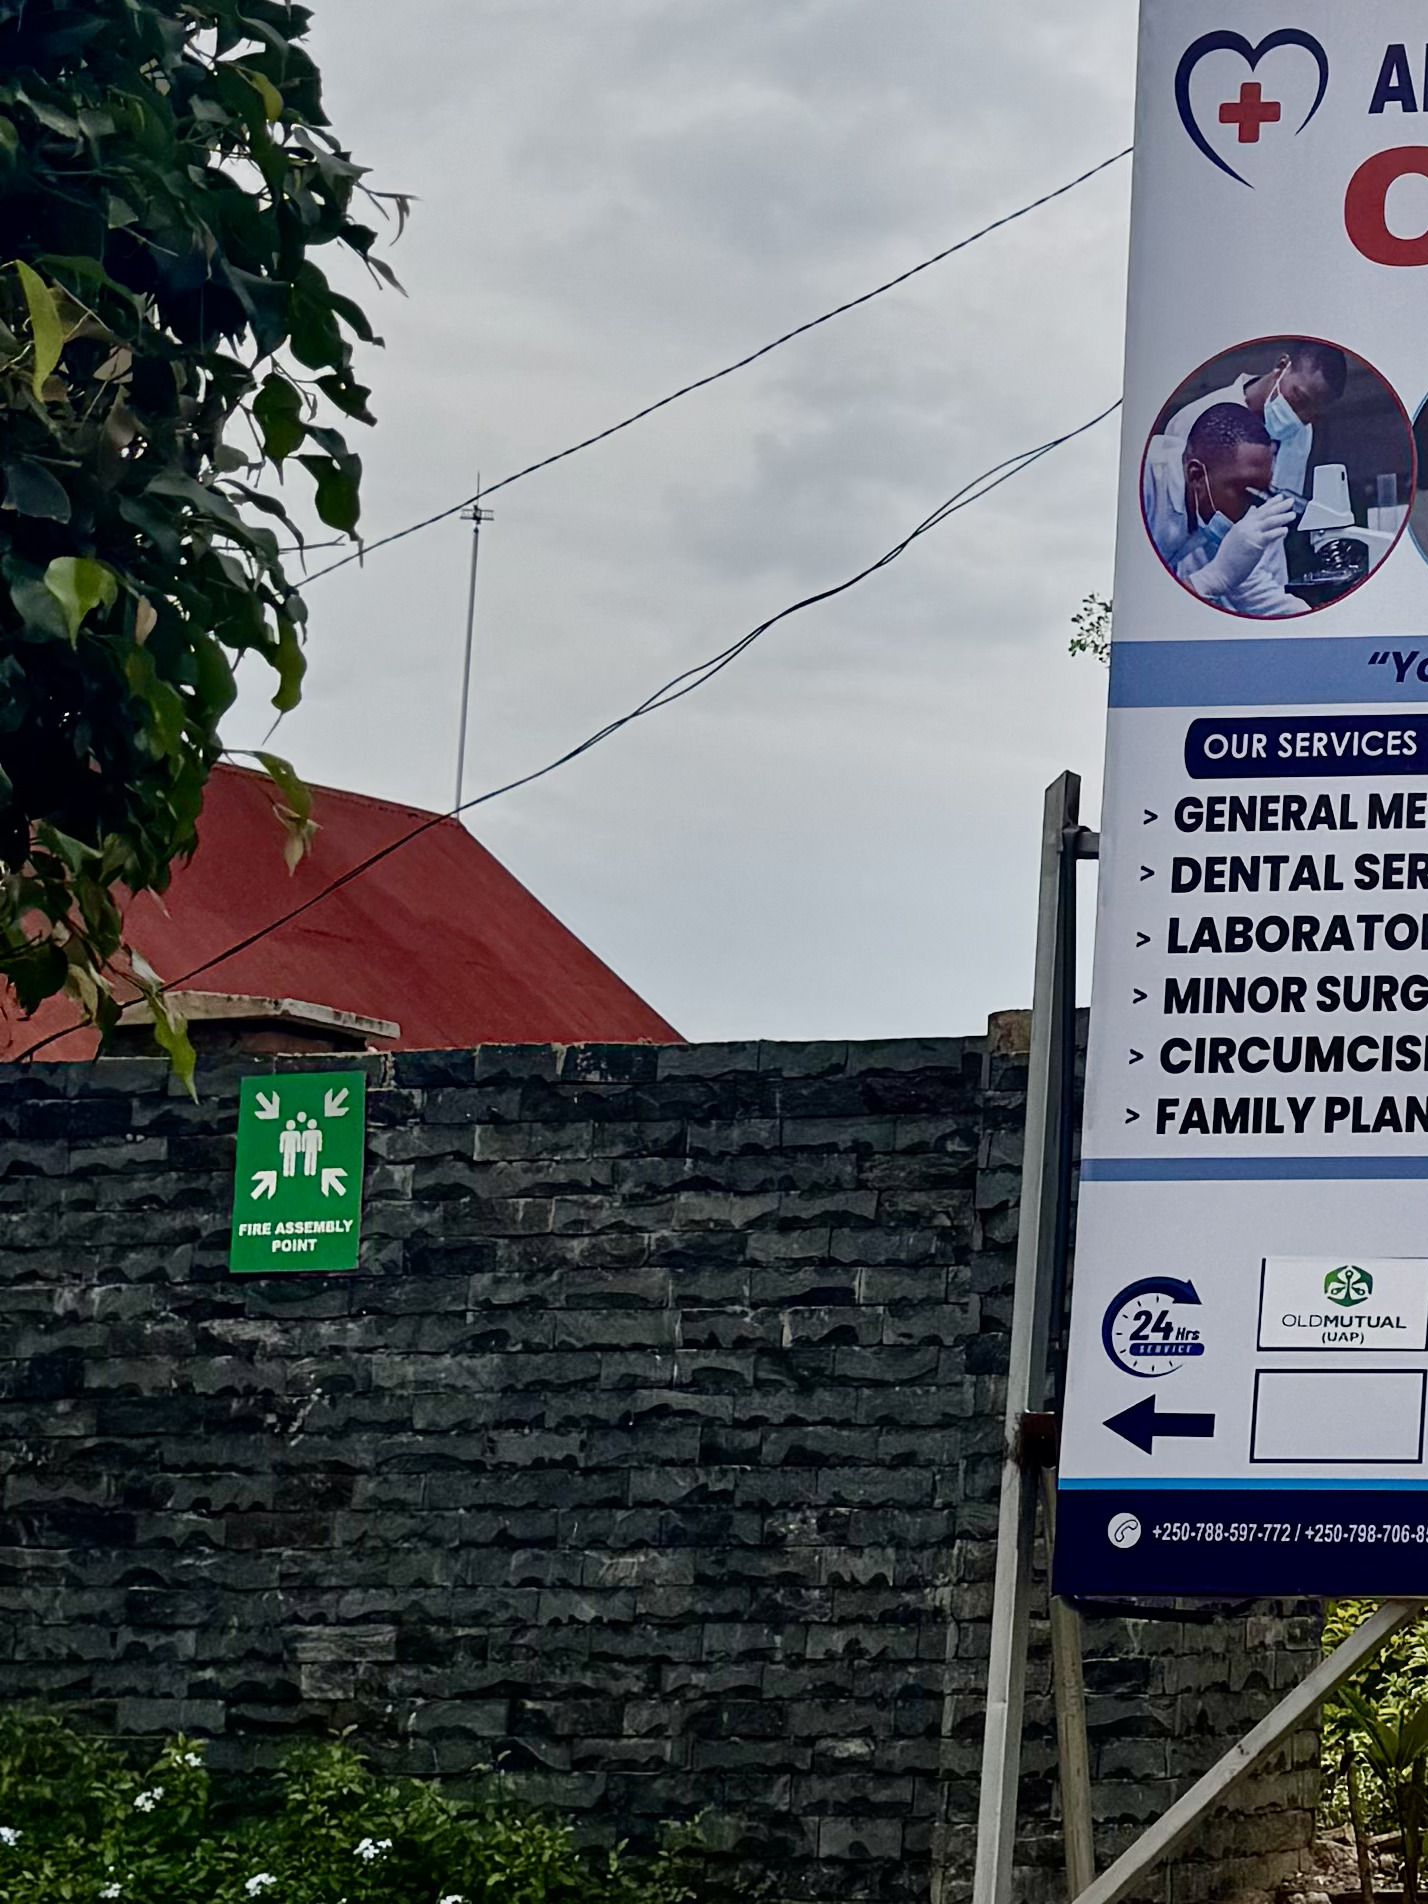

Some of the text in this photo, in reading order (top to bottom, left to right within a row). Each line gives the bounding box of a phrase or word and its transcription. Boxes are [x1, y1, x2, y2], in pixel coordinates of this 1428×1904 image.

[1204, 731, 1417, 759] OUR SERVICES
[1175, 794, 1358, 832] GENERAL
[1171, 855, 1343, 893] DENTAL
[1164, 977, 1307, 1014] MINOR
[1157, 1097, 1316, 1134] FAMILY
[239, 1220, 353, 1236] FIRE ASSEMBLY
[272, 1239, 317, 1252] POINT
[1129, 1309, 1200, 1341] 24 Hrs
[1322, 1332, 1364, 1344] (UAP)
[1153, 1523, 1290, 1541] +250-788-597-772
